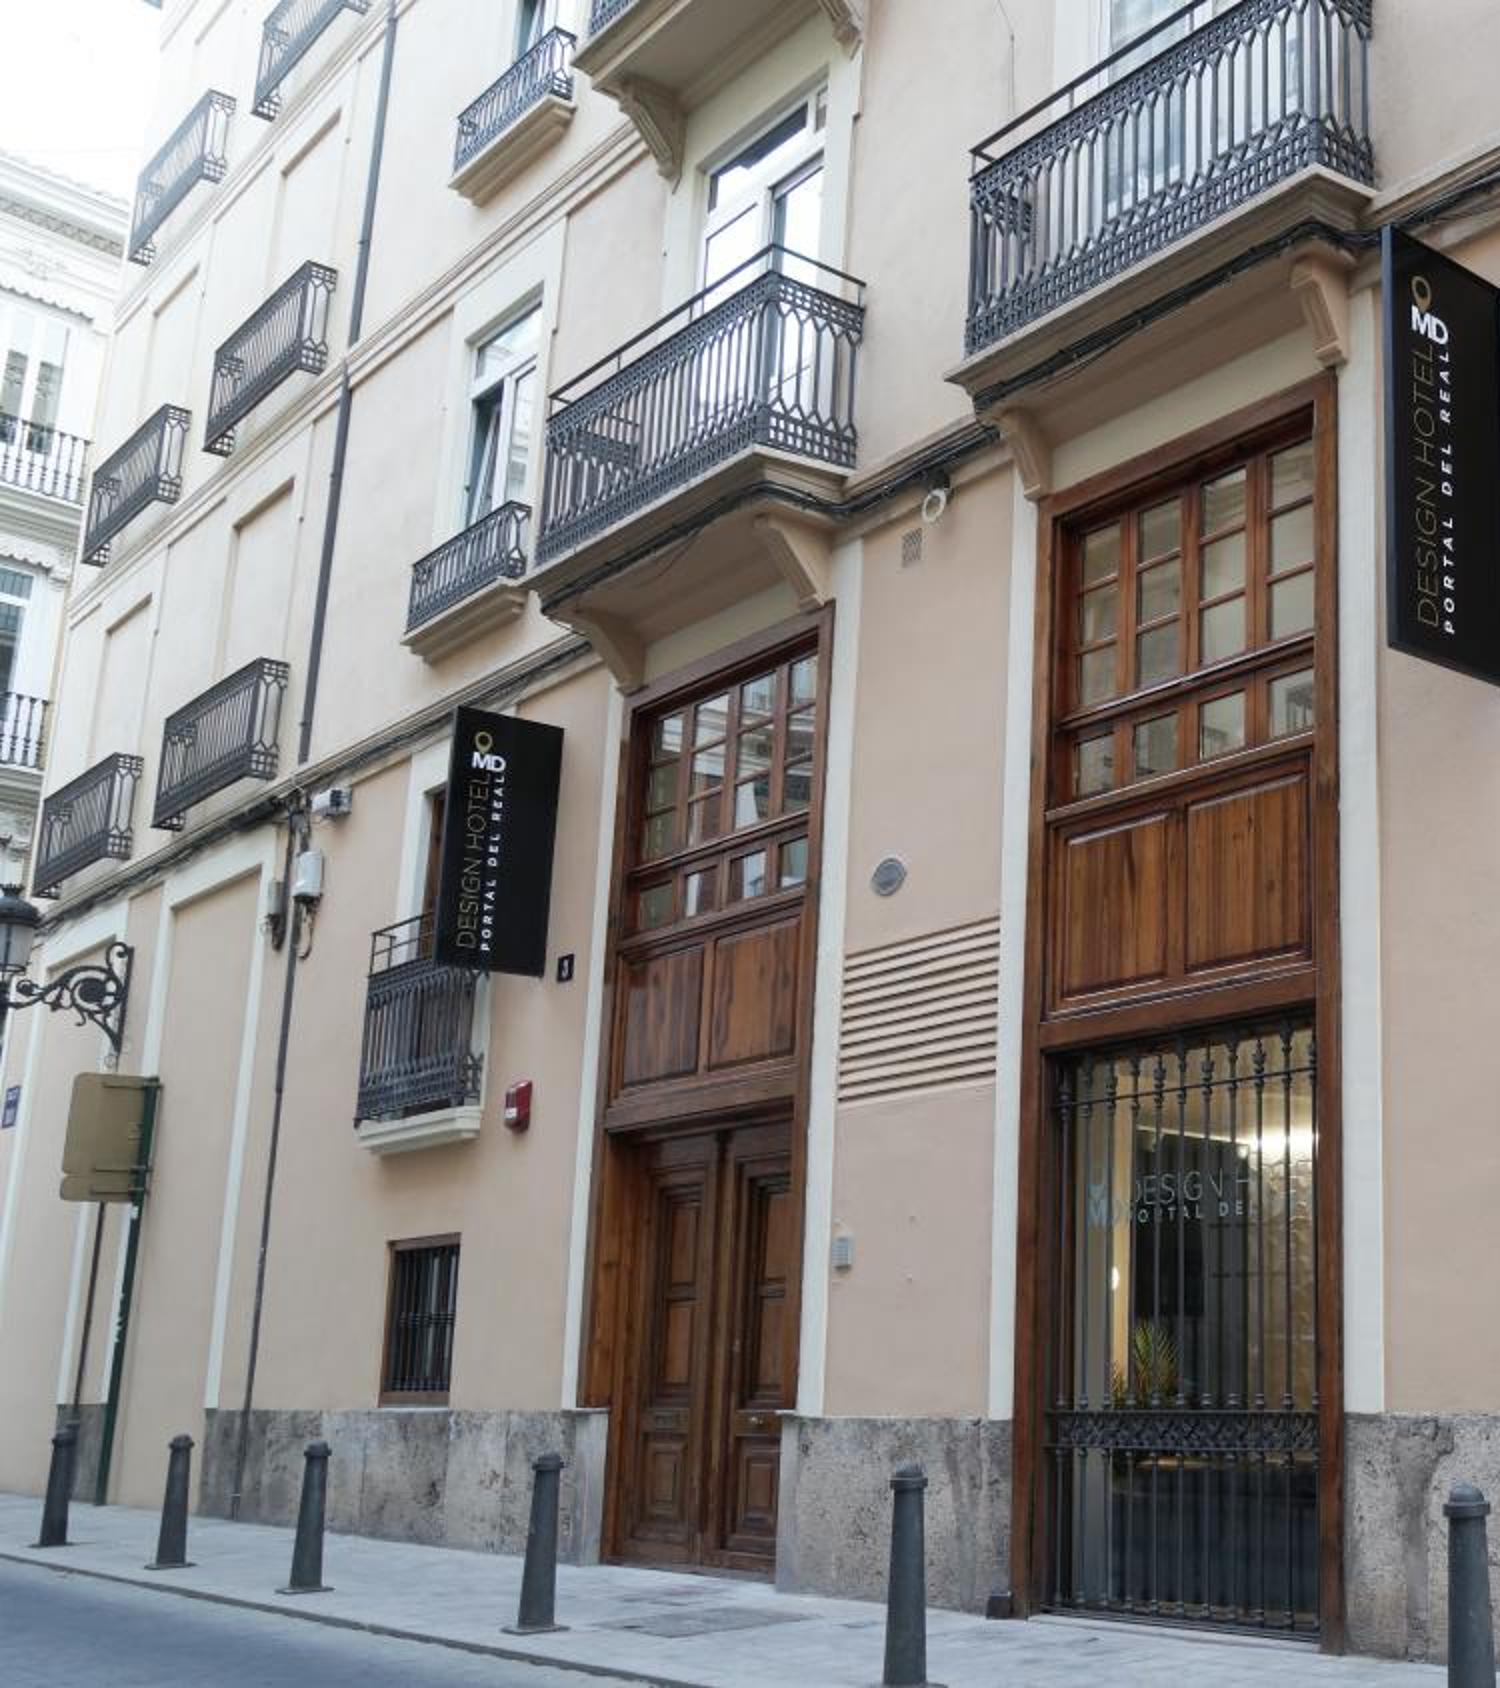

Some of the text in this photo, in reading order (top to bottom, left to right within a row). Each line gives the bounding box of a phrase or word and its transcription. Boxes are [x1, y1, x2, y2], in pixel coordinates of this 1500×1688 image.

[1411, 304, 1449, 345] MD
[1412, 345, 1439, 628] DESIGN HOTEL
[1439, 351, 1456, 634] PORTAL DEL REAL
[471, 751, 507, 772] MD
[456, 774, 491, 949] DESIGN HOTEL
[480, 775, 505, 951] PORTAL DEL REAL
[1130, 1202, 1203, 1224] OTAL
